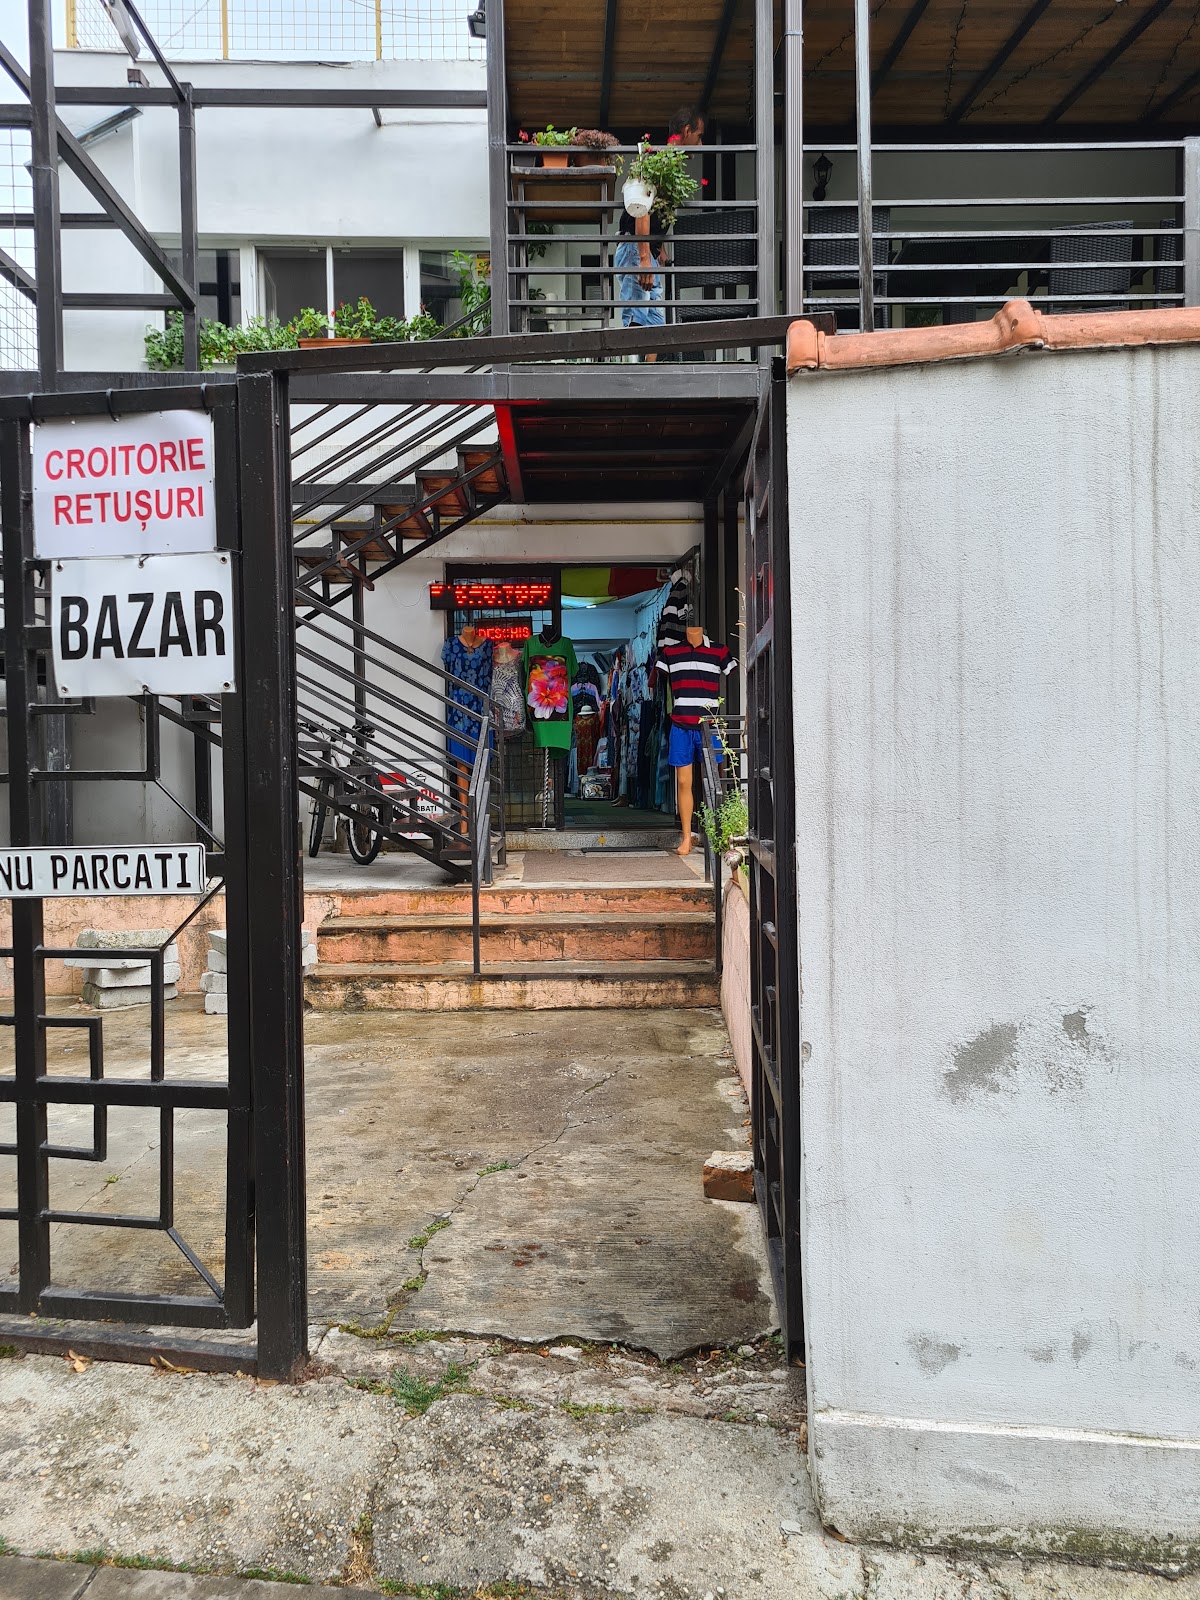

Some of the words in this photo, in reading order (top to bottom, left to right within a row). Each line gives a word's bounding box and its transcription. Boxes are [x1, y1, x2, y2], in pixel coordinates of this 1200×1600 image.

[45, 438, 206, 481] CROITORIE
[60, 590, 226, 660] BAZAR
[478, 627, 531, 640] DESCHIS
[0, 856, 33, 890] NU
[50, 853, 192, 890] PARCATI
